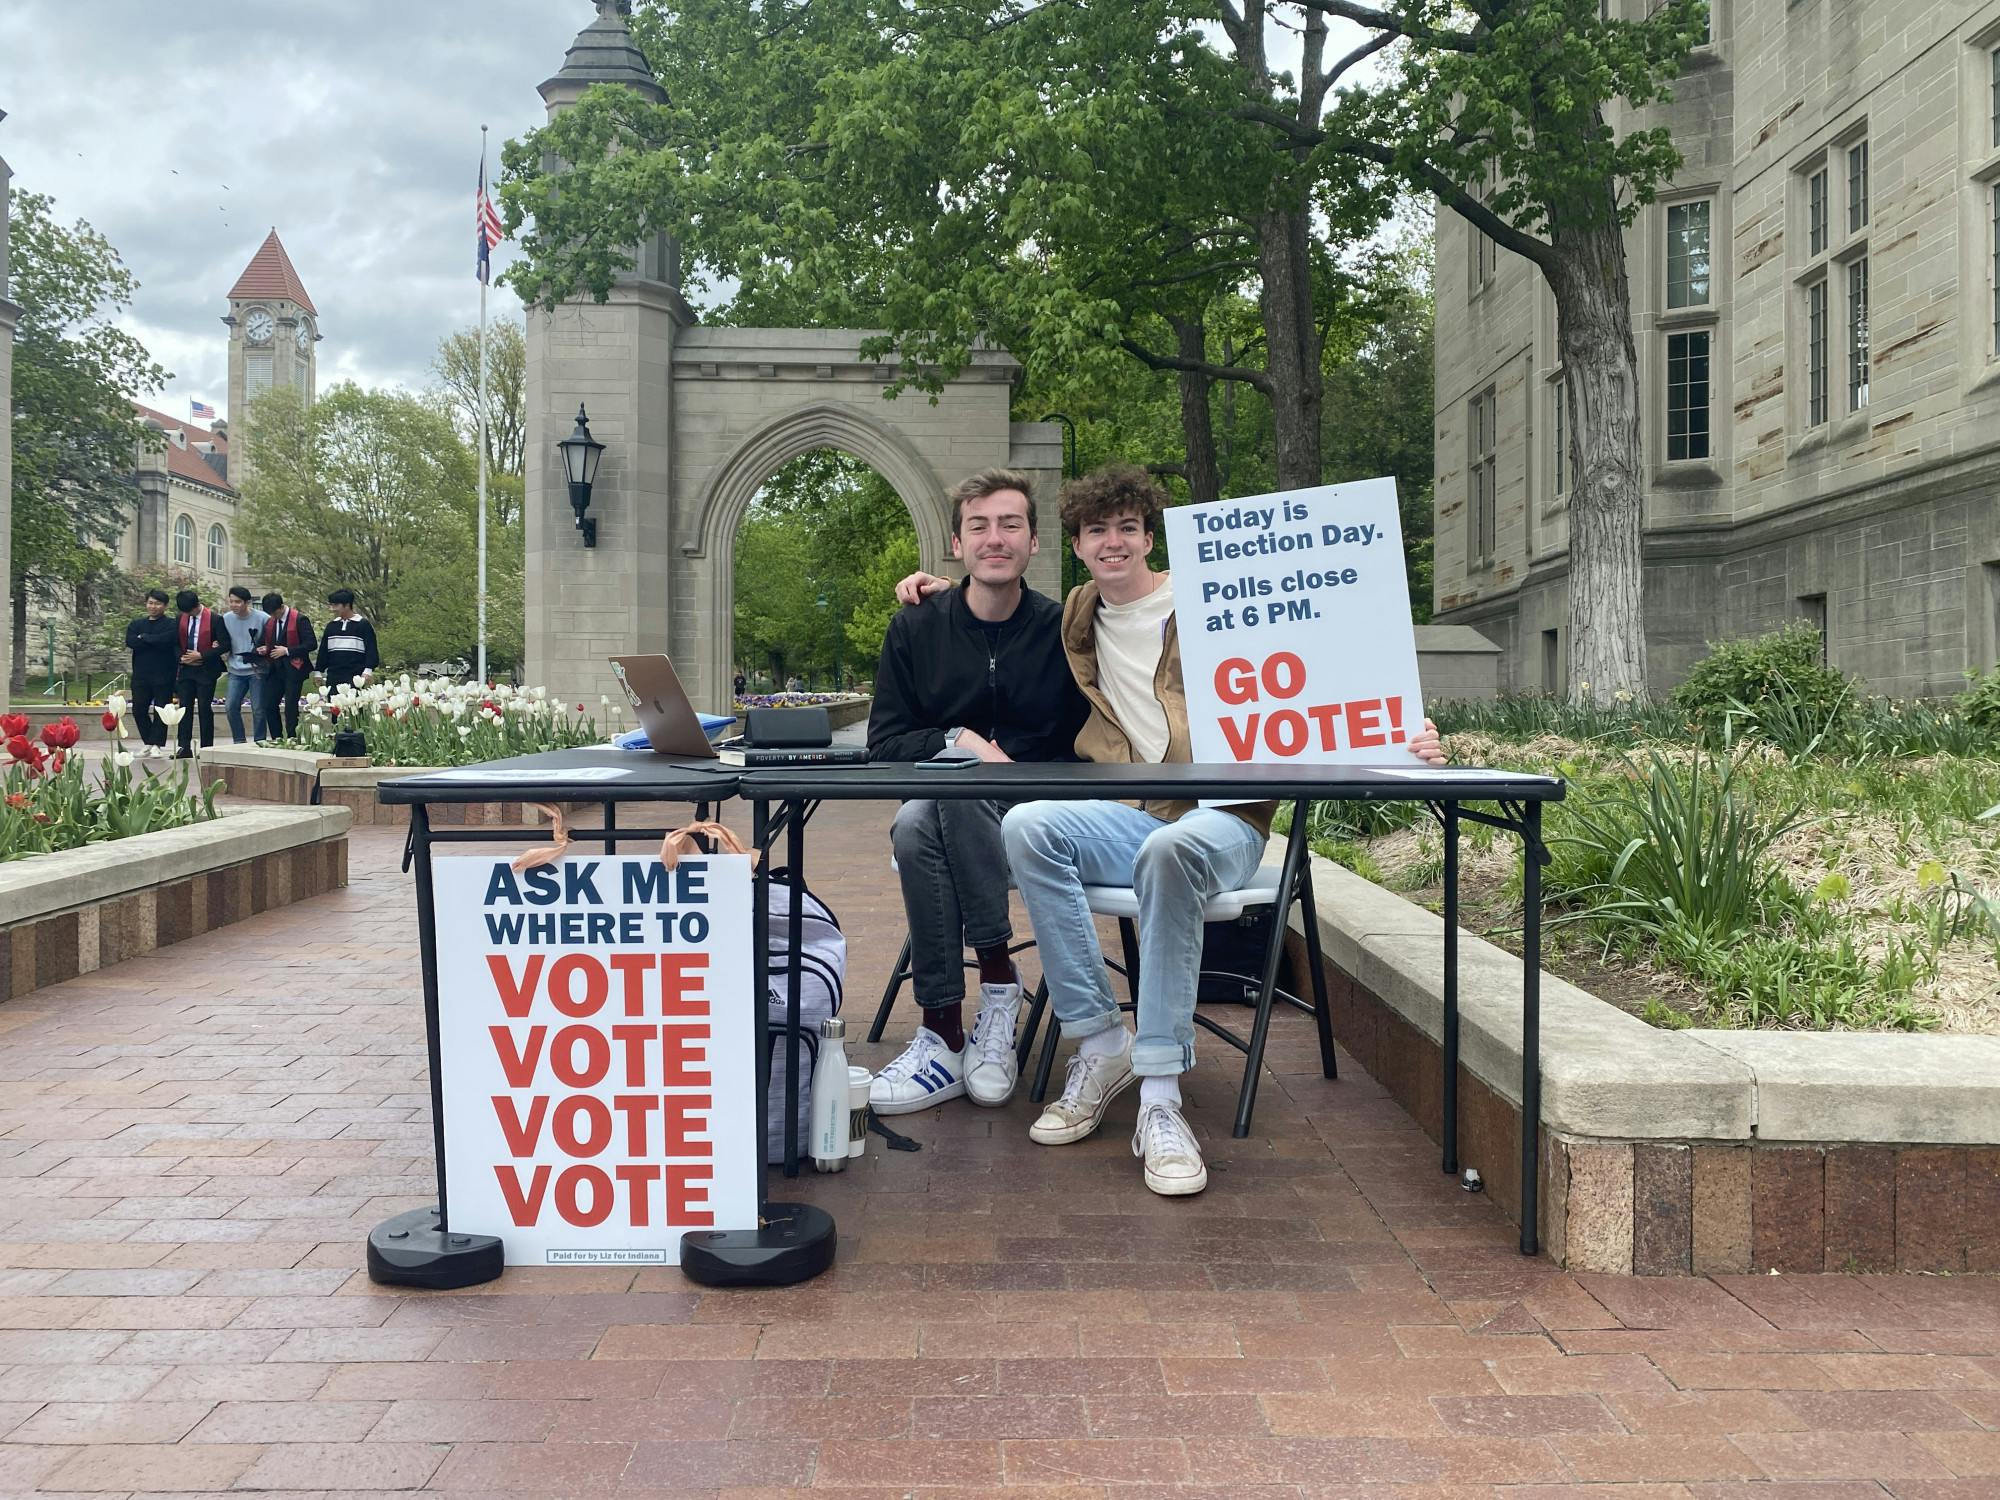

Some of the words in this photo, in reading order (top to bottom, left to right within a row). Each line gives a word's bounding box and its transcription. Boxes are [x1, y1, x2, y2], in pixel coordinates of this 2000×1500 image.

[1192, 508, 1275, 535] Today
[1283, 500, 1309, 522] is
[1197, 531, 1313, 564] Election
[1321, 522, 1384, 547] Day.
[1202, 576, 1274, 604] Polls
[1280, 567, 1358, 594] close
[1206, 609, 1235, 632] at
[1241, 605, 1260, 627] 6
[1267, 598, 1321, 625] PM.
[1214, 651, 1307, 706] GO
[1217, 695, 1406, 763] VOTE!
[484, 862, 604, 906] ASK
[622, 861, 709, 905] ME
[484, 912, 645, 945] WHERE
[655, 911, 710, 944] TO
[485, 953, 711, 1018] VOTE
[488, 1024, 712, 1088] VOTE
[490, 1094, 714, 1158] VOTE
[493, 1164, 715, 1227] VOTE
[553, 1252, 572, 1260] Paid
[574, 1252, 586, 1260] for
[588, 1252, 598, 1261] by
[599, 1252, 612, 1260] Liz
[613, 1252, 626, 1260] for
[628, 1252, 660, 1260] Indiana
